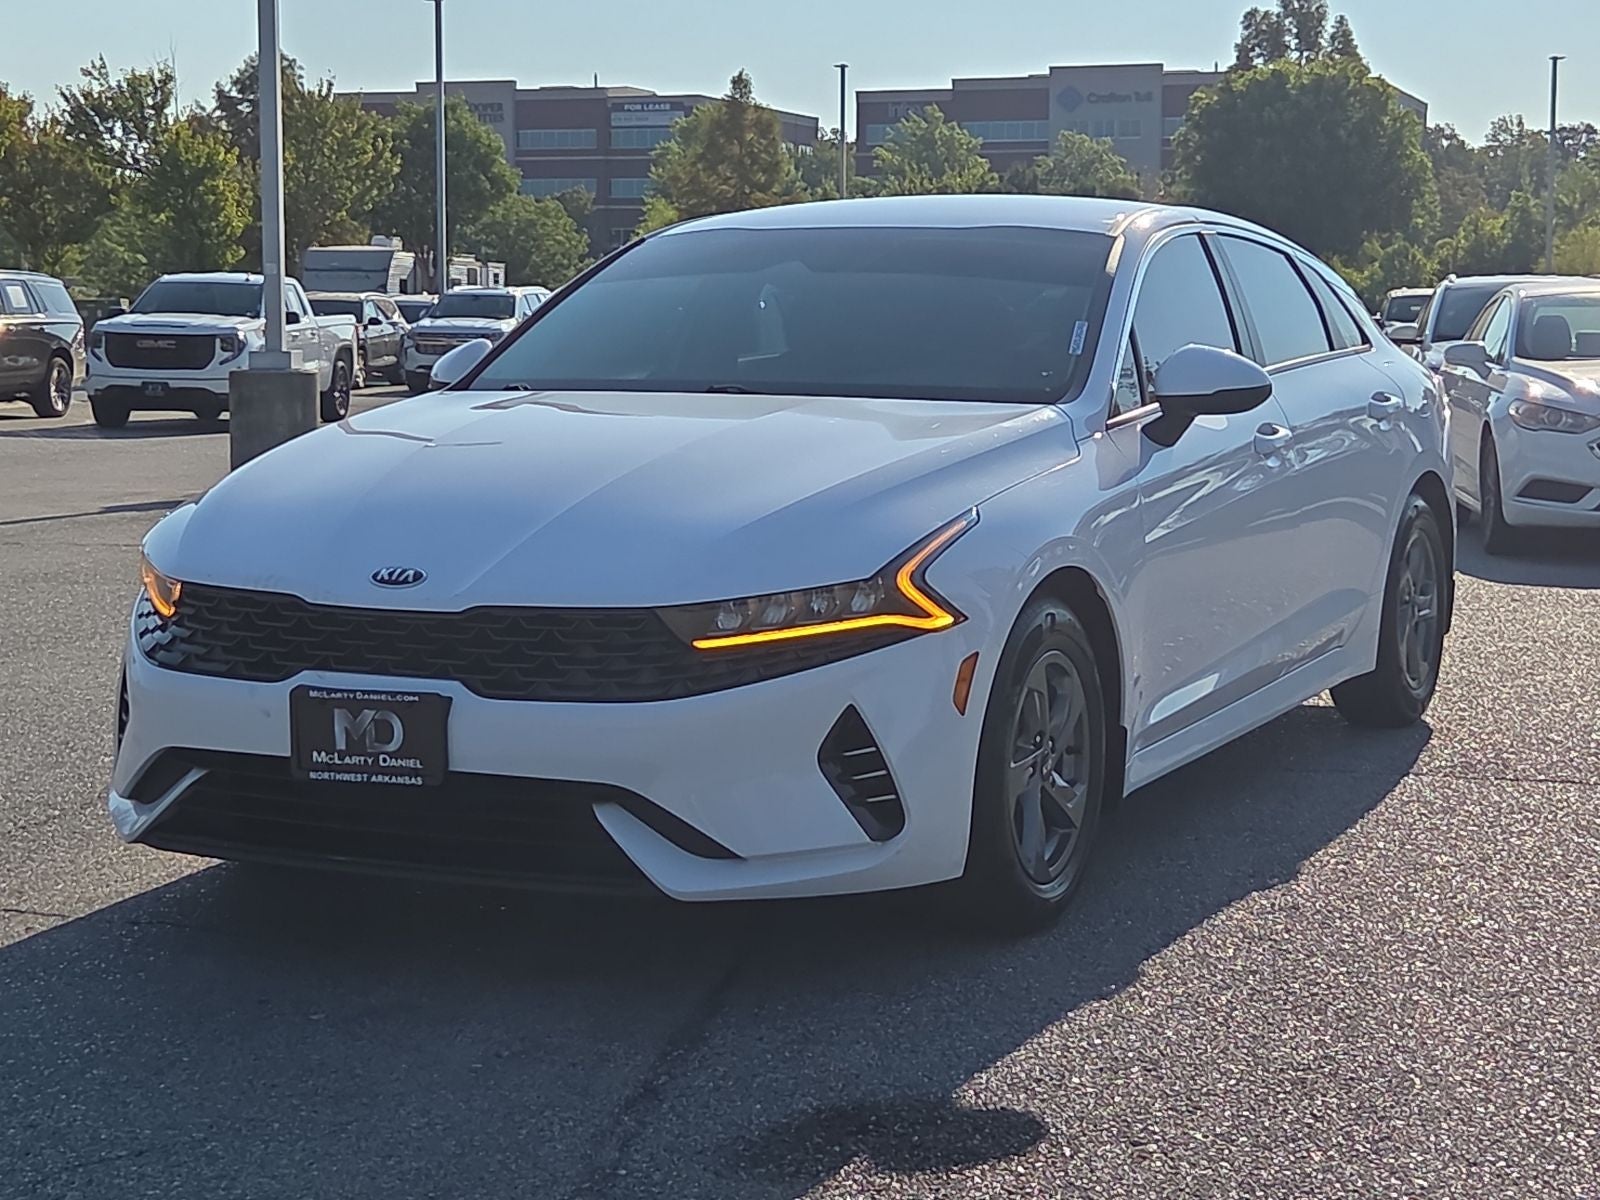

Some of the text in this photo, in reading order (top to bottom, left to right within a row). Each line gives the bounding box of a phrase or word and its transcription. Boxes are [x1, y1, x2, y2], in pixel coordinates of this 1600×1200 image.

[624, 103, 671, 111] FOR LEASE
[135, 339, 177, 349] GMC
[376, 567, 416, 583] KIA
[333, 707, 405, 753] MD
[378, 754, 424, 769] DANIEL
[309, 771, 424, 786] NORTHWEST ARKANSAS
